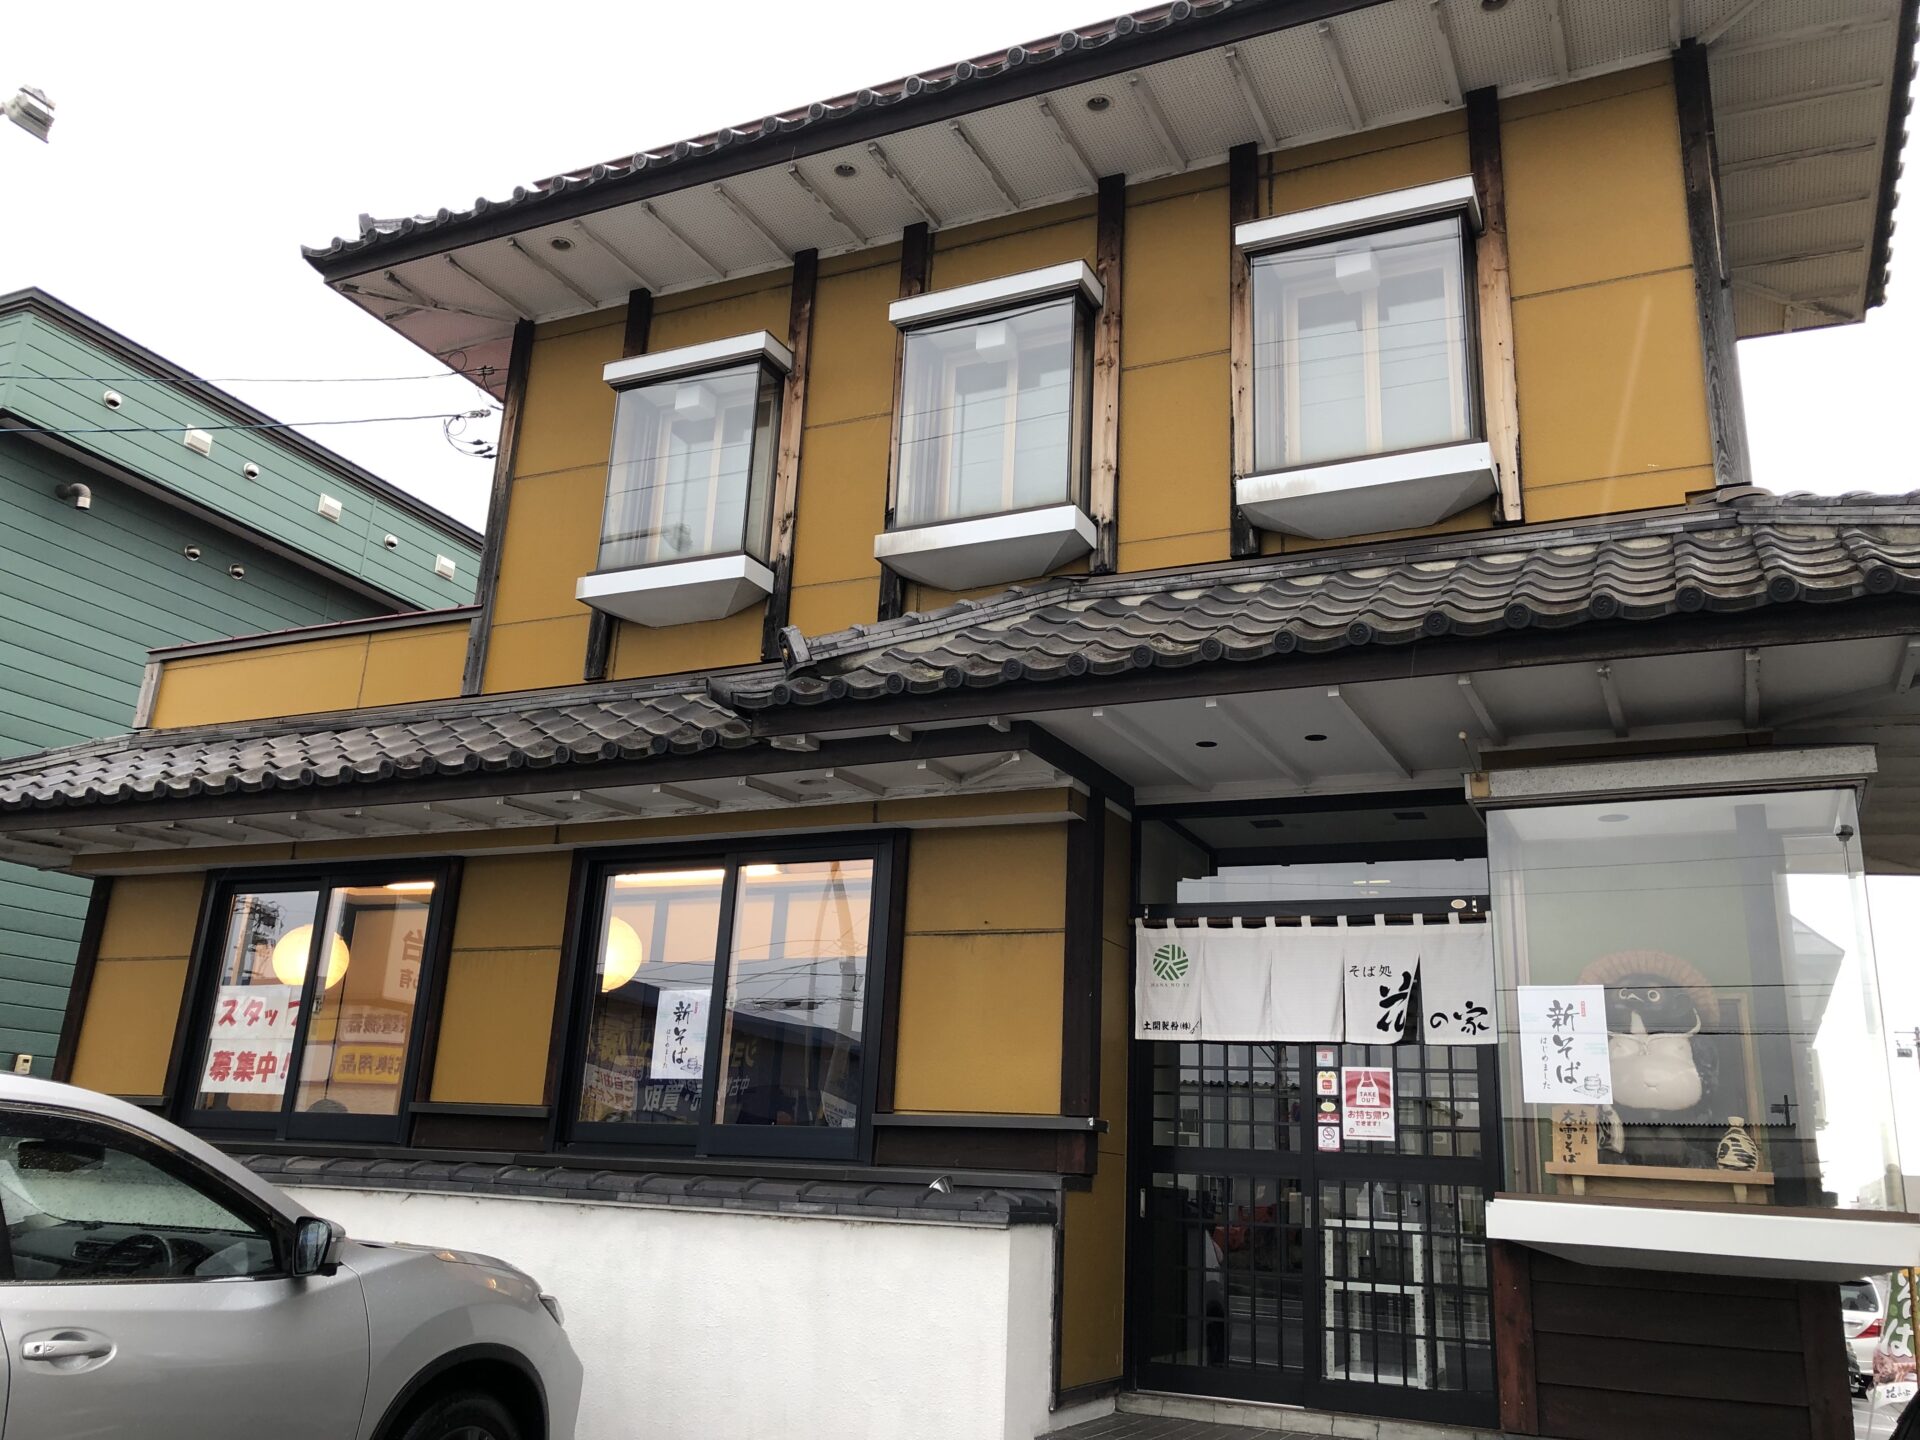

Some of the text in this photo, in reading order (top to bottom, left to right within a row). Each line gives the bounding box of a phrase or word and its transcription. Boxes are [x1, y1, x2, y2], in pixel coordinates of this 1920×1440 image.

[1349, 965, 1392, 978] そば処
[1376, 970, 1490, 1036] 花の家
[672, 1000, 694, 1065] 新そば
[1546, 999, 1581, 1085] 新そば
[209, 1051, 292, 1083] 募集中!
[1540, 1036, 1551, 1089] はじめました
[1347, 1110, 1390, 1120] お持ち帰り
[1559, 1109, 1581, 1163] 大雪そば
